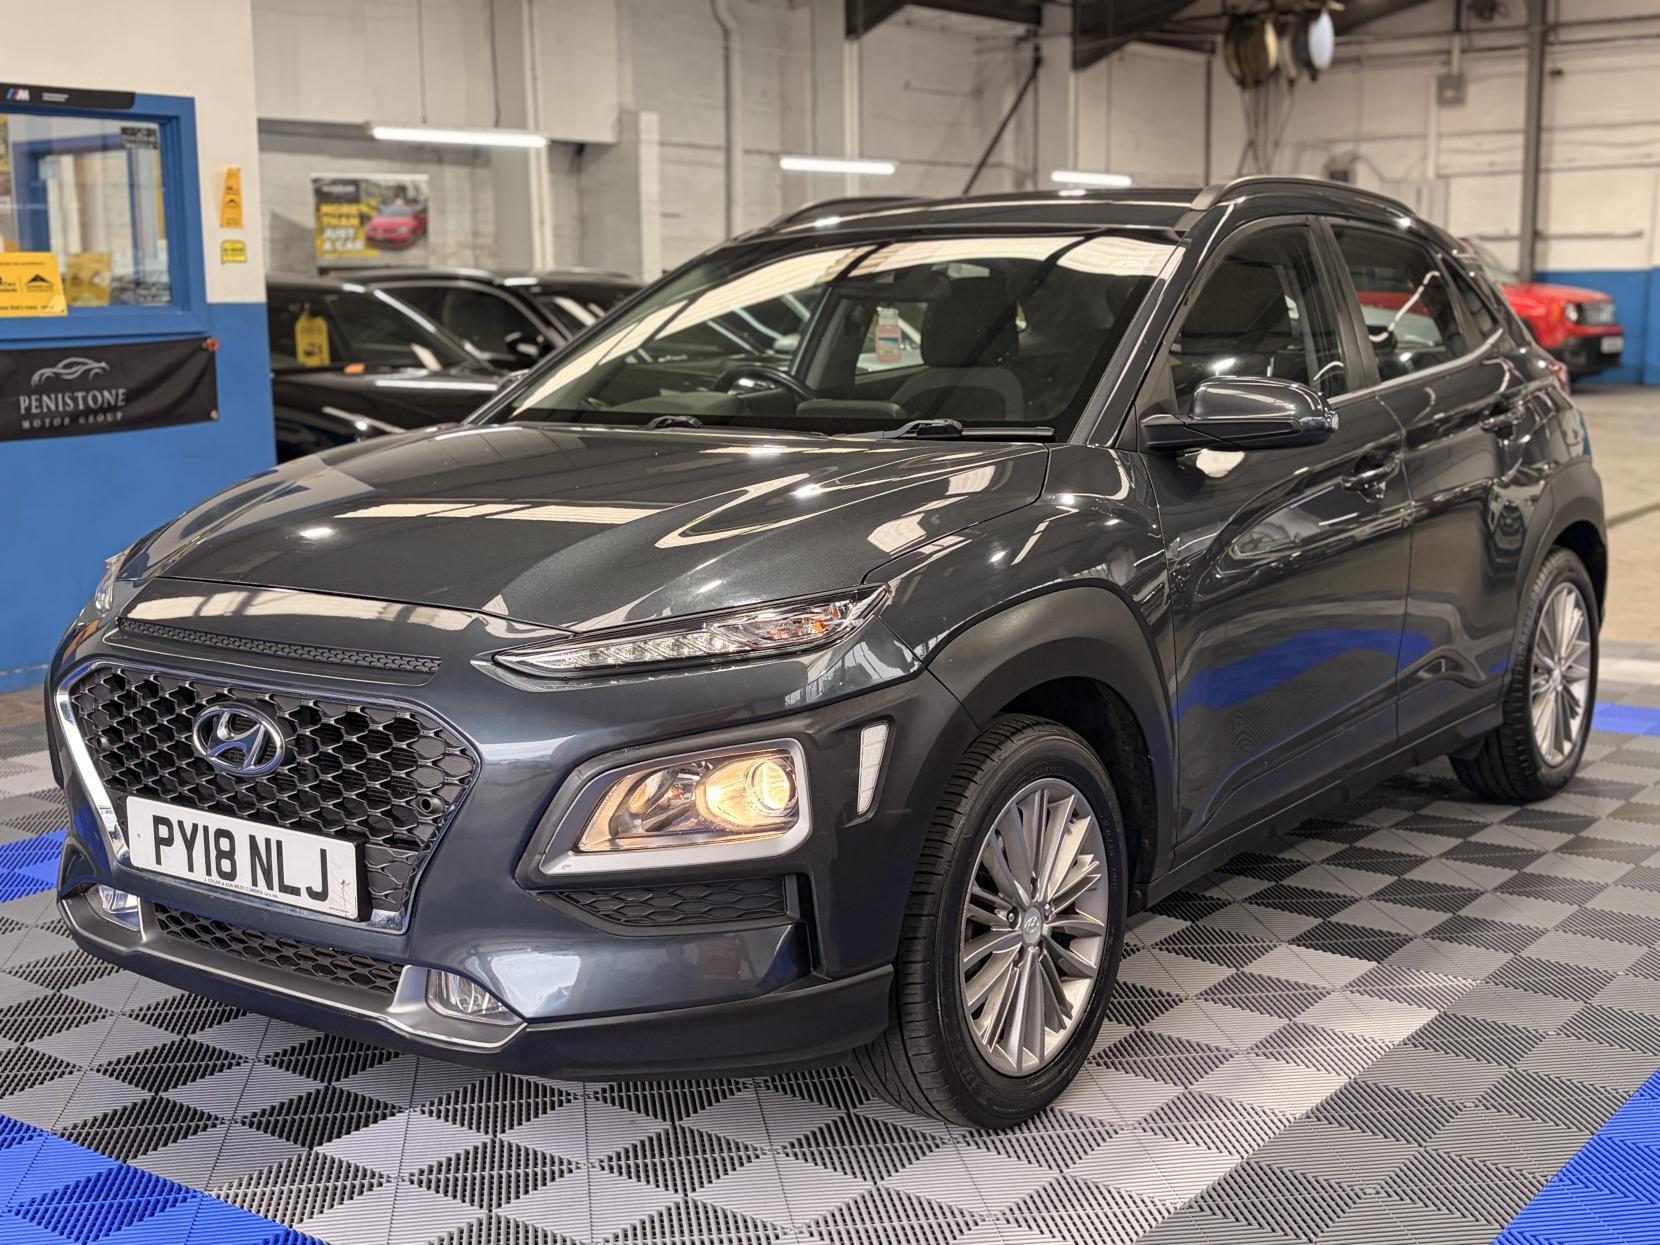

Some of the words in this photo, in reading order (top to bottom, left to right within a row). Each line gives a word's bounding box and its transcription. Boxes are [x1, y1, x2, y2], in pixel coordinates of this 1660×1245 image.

[18, 388, 127, 415] PENISTONE
[21, 417, 71, 430] MOTOR
[78, 411, 123, 425] GROUP
[152, 814, 237, 882] PY18
[249, 833, 330, 902] NLJ
